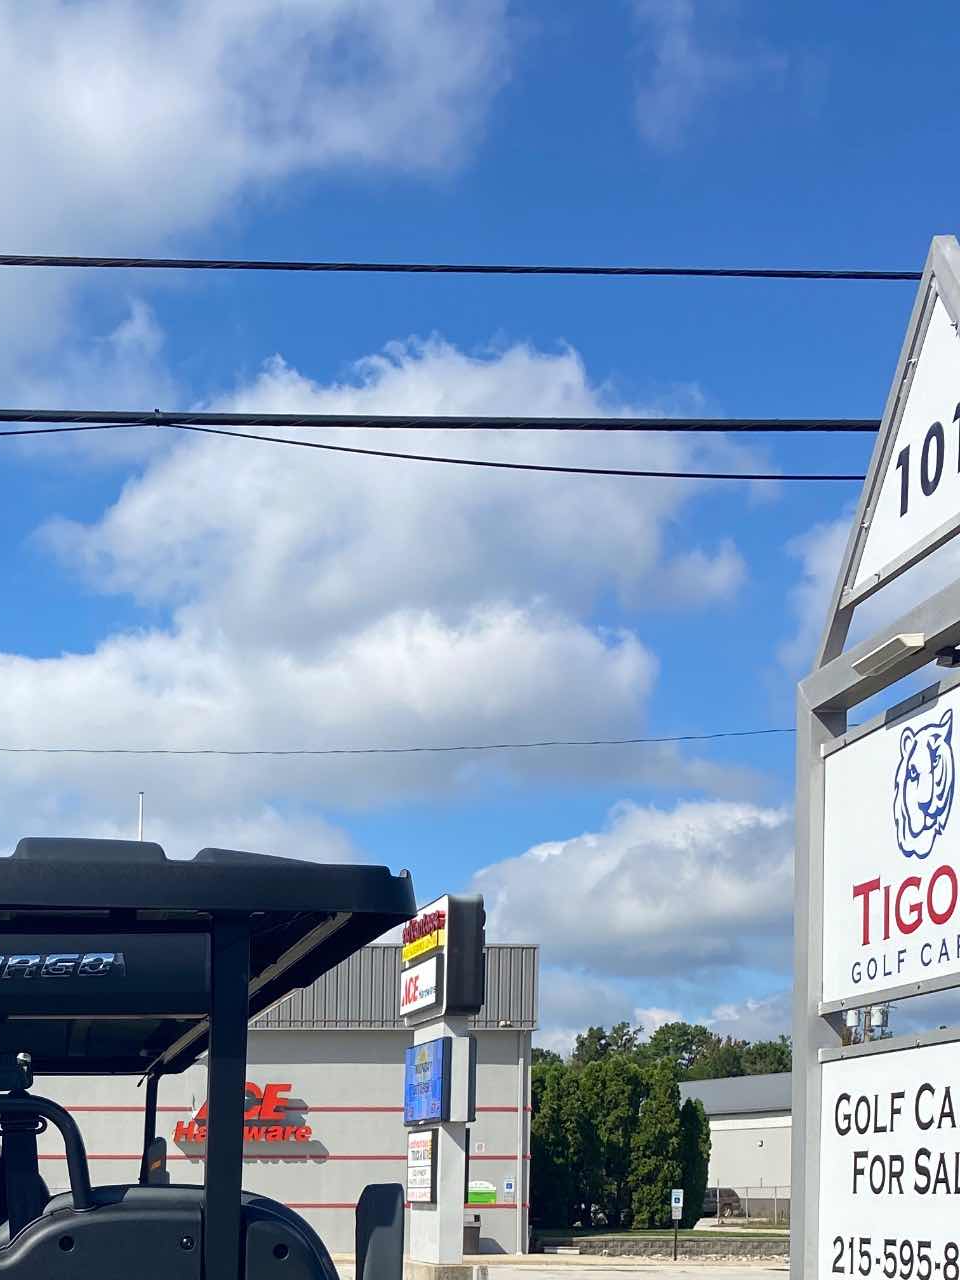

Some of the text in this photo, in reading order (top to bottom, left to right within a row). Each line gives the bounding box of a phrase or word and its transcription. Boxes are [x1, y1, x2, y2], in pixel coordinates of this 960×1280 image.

[851, 948, 907, 984] GOLF
[401, 974, 419, 1007] ACE
[174, 1120, 312, 1142] Haware
[835, 1090, 906, 1136] GOLF
[852, 1150, 905, 1195] FOR
